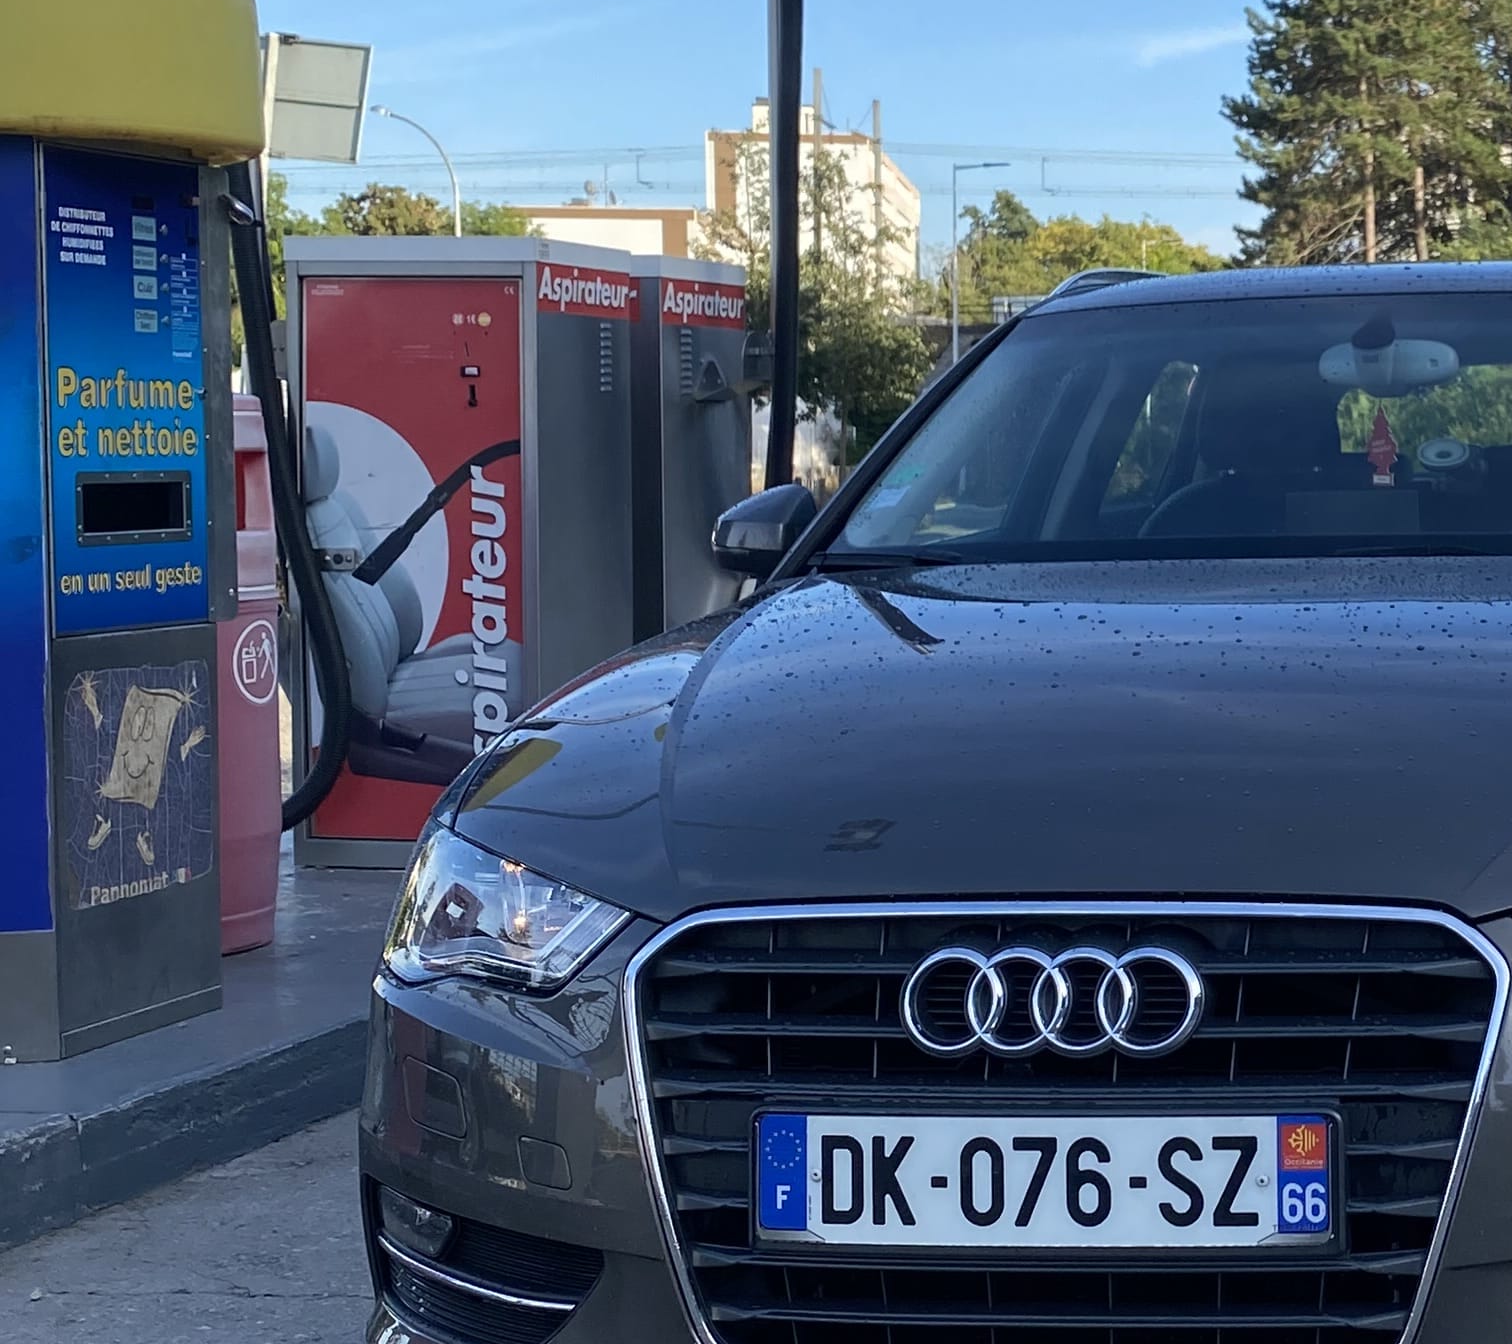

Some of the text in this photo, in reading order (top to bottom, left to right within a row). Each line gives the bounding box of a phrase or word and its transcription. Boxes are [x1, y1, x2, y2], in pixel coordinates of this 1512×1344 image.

[51, 221, 60, 232] DE
[58, 207, 106, 222] DISTRIBUTEUR
[538, 265, 630, 313] Aspirateur
[663, 281, 744, 324] Aspirateur
[56, 366, 194, 410] Parfume
[57, 418, 199, 457] et nettoie
[59, 561, 203, 595] en un seul geste
[453, 465, 509, 757] pirateur
[776, 1184, 791, 1210] F
[821, 1135, 1259, 1228] DK-076-SZ
[1282, 1182, 1327, 1224] 66
